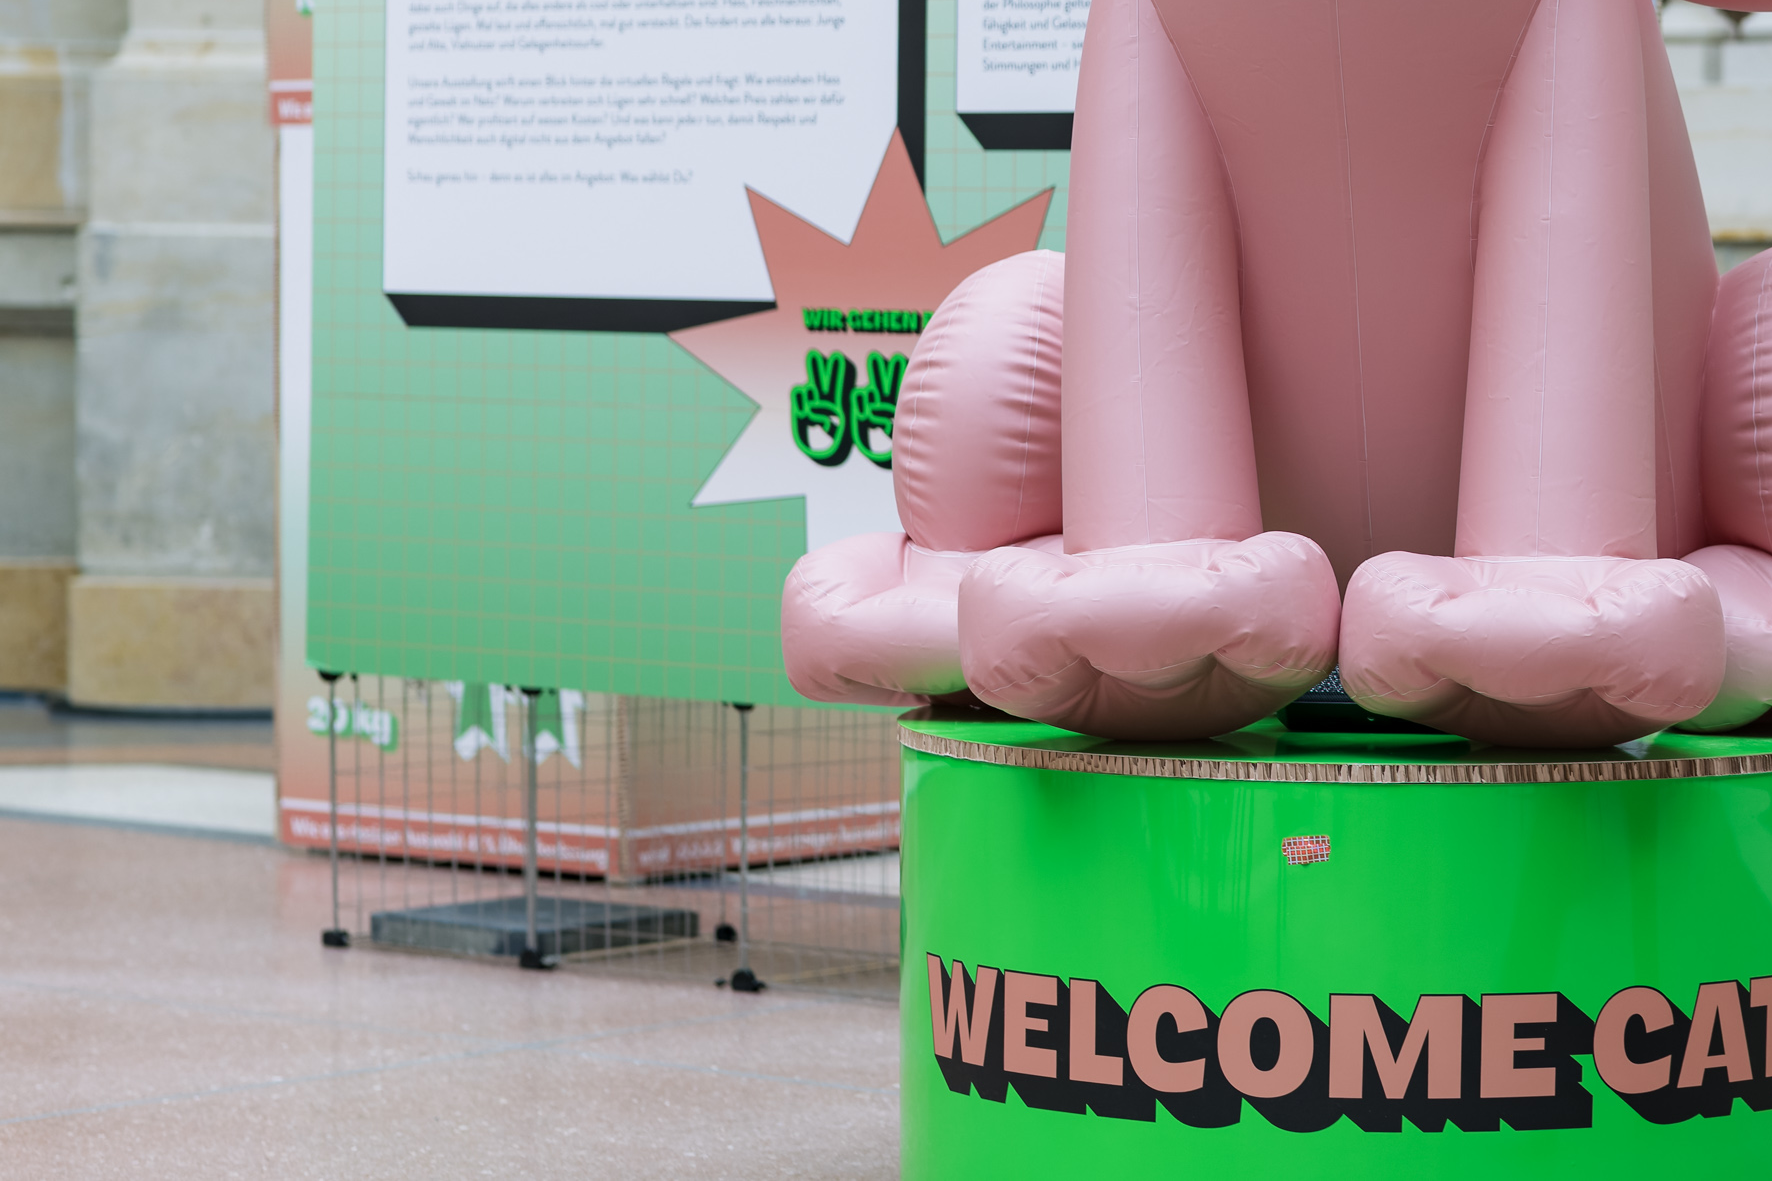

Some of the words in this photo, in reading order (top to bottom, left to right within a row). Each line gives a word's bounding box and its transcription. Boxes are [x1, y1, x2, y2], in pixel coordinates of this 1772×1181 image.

[802, 307, 847, 332] WIR
[846, 308, 921, 334] GEHEN
[306, 695, 351, 736] 20
[351, 698, 394, 748] kg
[926, 951, 1593, 1132] WELCOME
